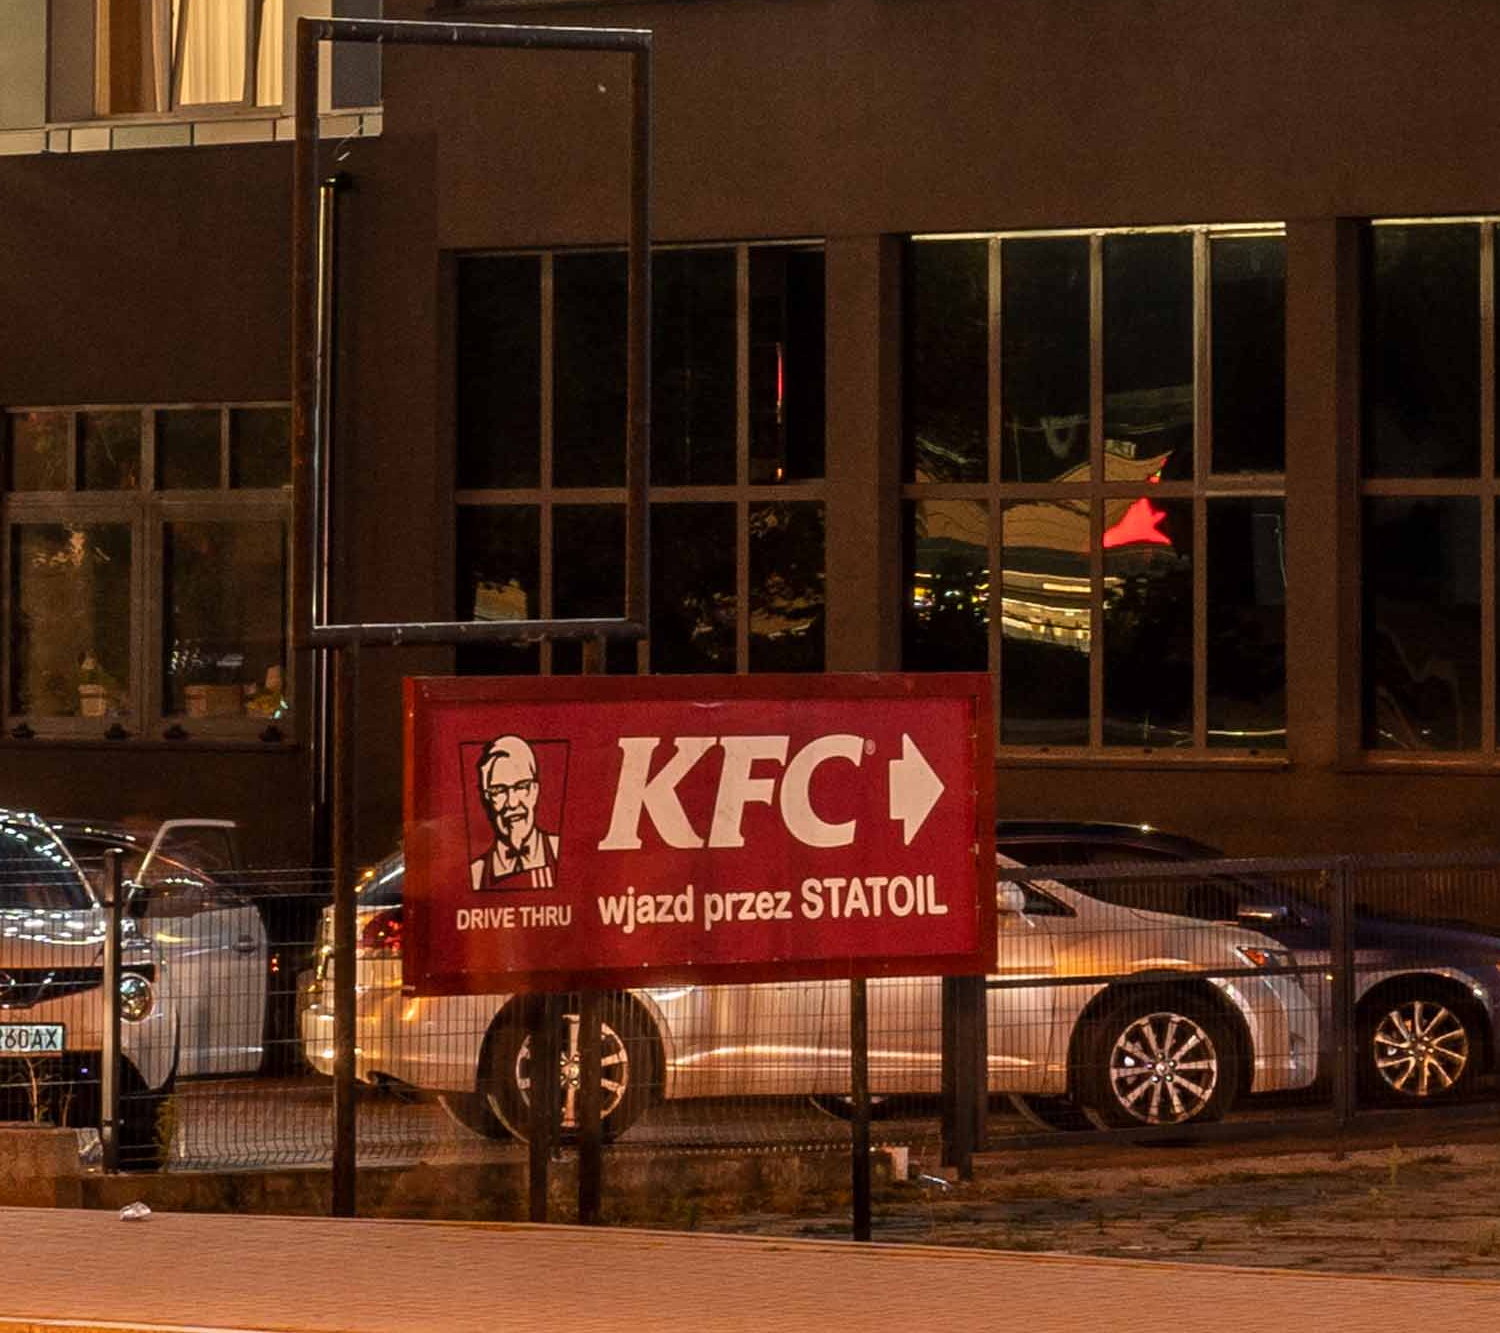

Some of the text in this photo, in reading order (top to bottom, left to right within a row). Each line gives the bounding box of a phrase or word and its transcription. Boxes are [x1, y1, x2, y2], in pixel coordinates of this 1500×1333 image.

[597, 733, 866, 851] KFC
[456, 905, 573, 931] DRIVE THRU
[597, 874, 949, 935] wjazd przez STATOIL
